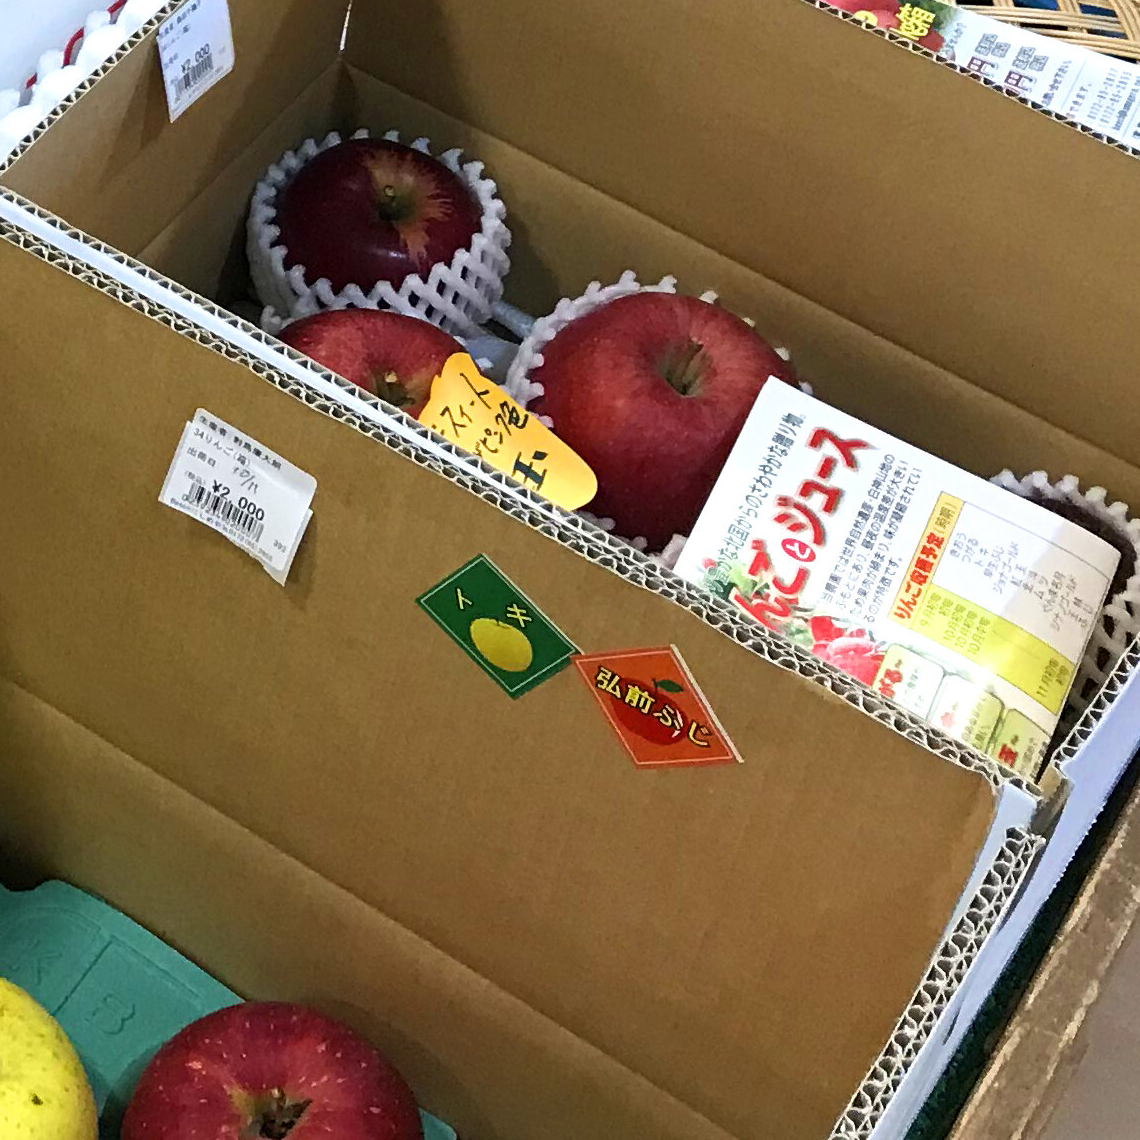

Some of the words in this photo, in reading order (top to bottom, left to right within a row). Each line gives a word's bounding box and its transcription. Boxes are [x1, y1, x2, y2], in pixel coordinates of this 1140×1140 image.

[456, 587, 533, 628] トキ
[595, 665, 712, 750] 弘前ふじ
